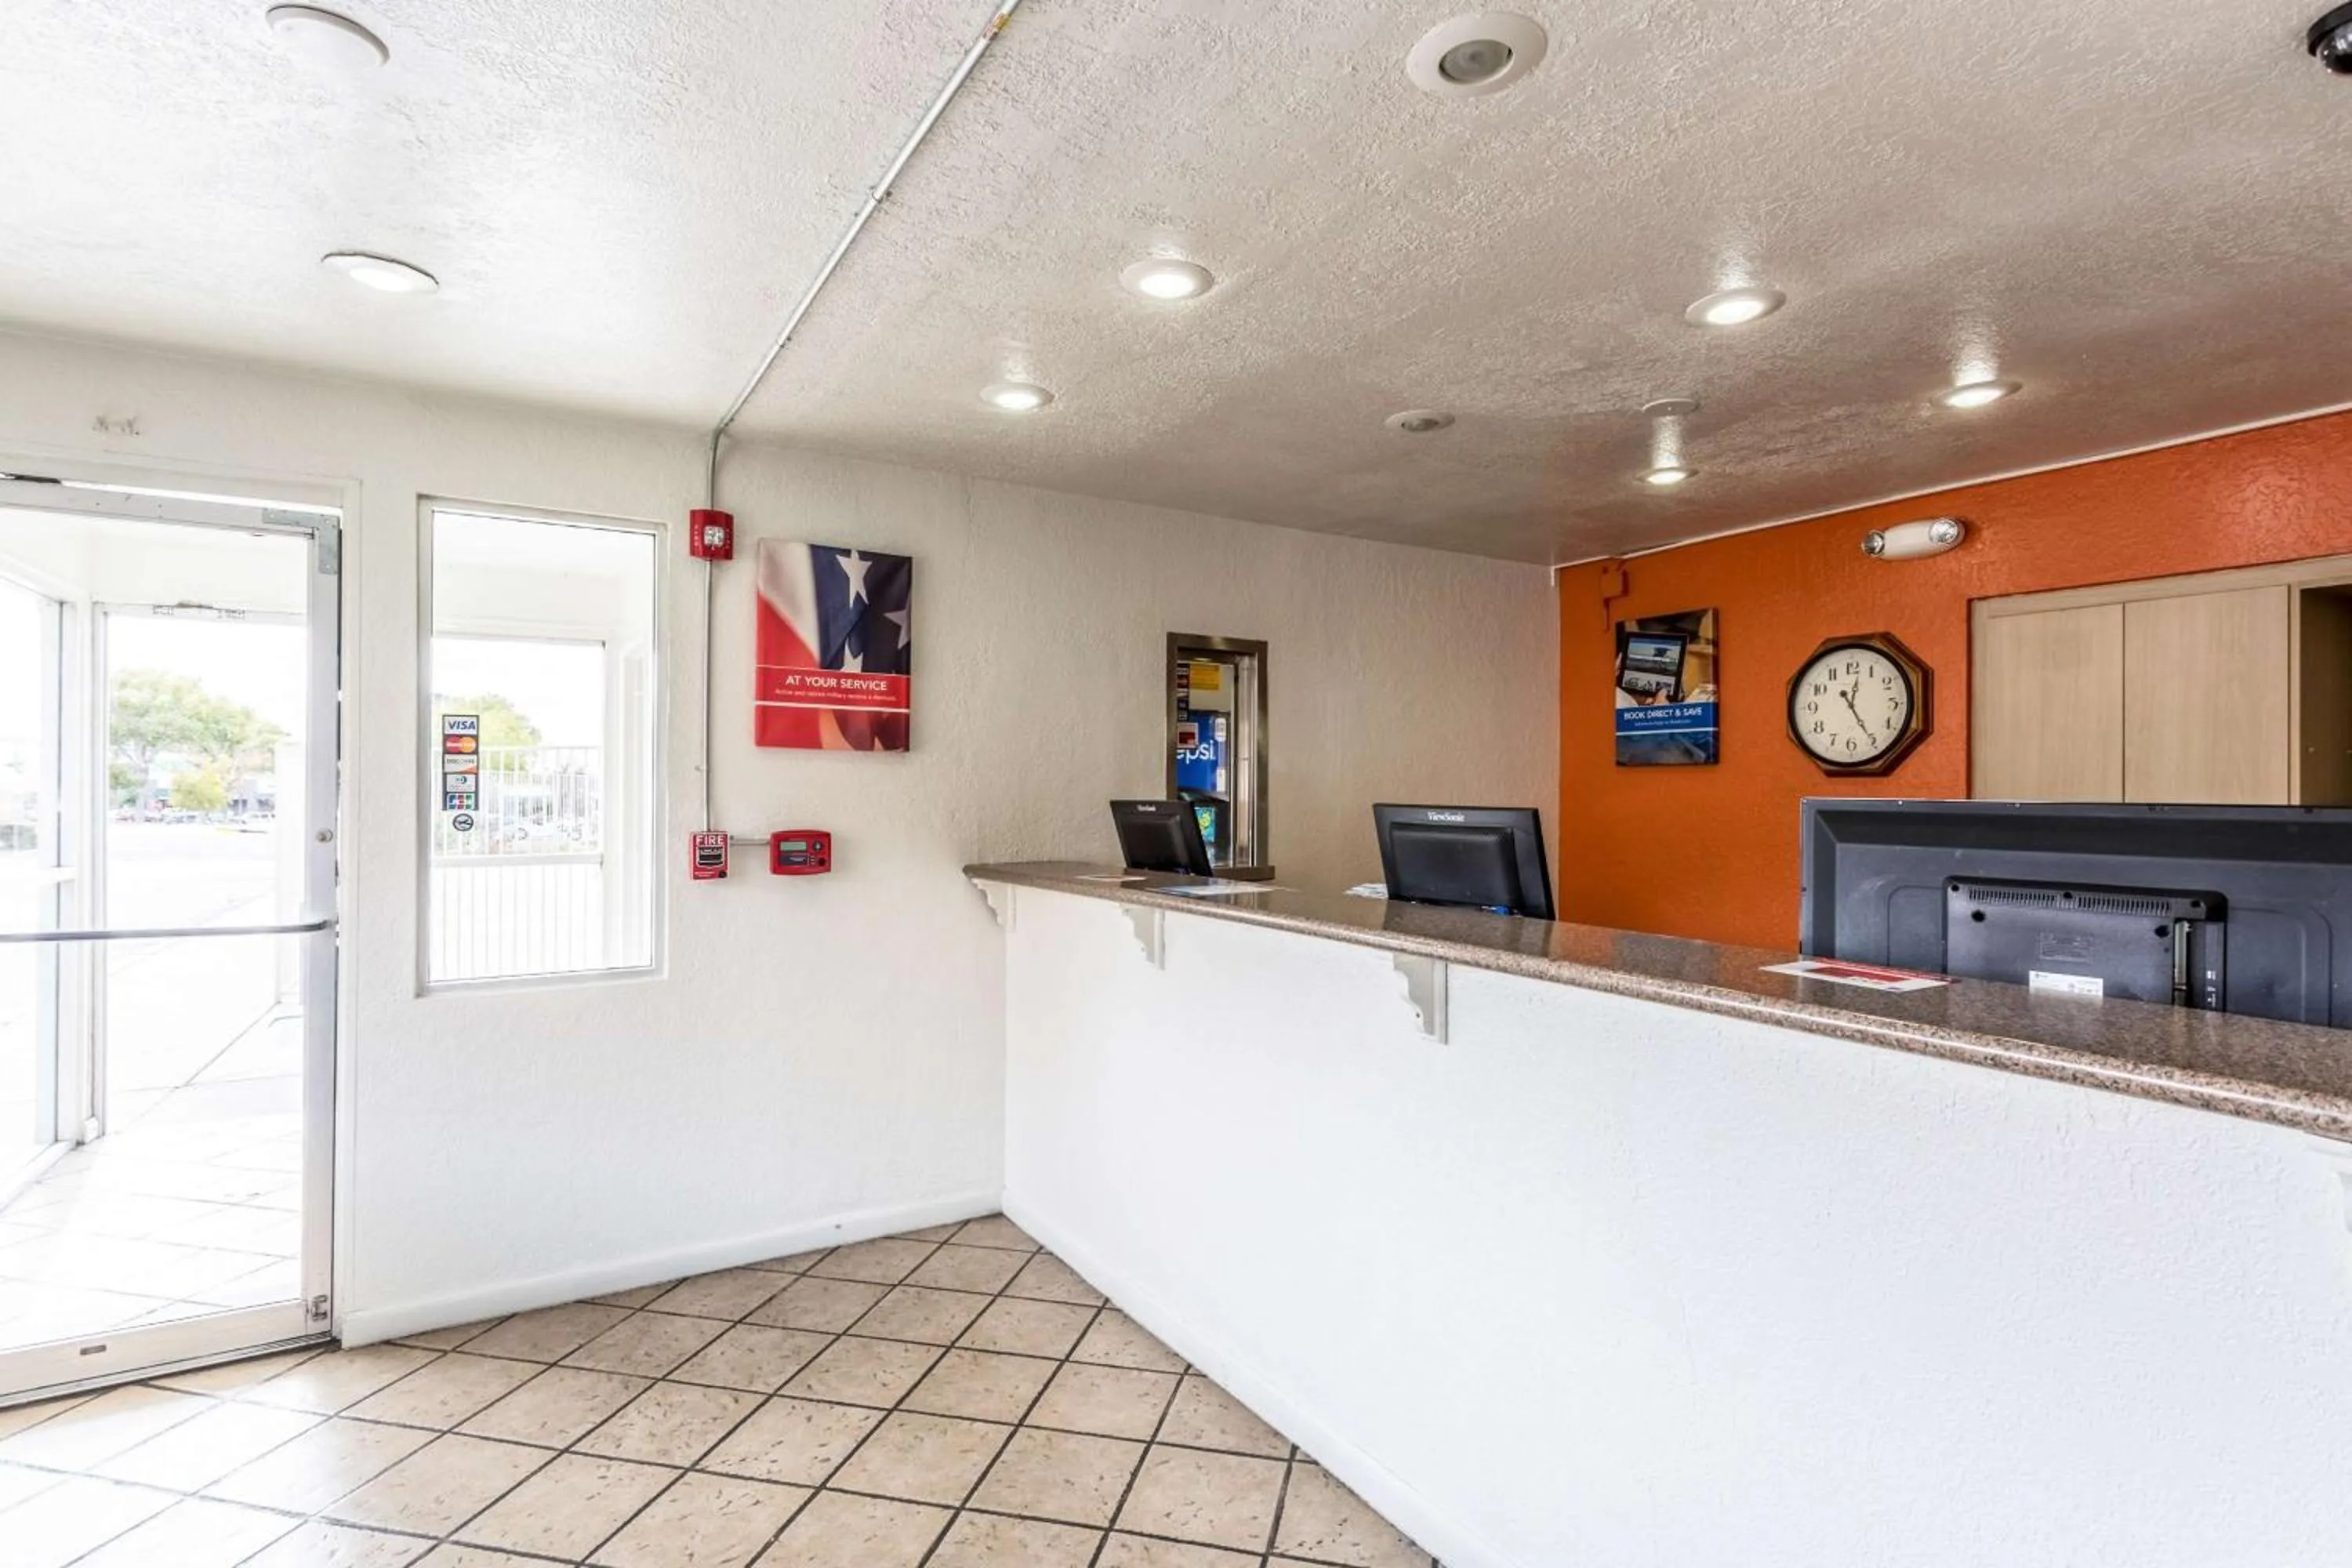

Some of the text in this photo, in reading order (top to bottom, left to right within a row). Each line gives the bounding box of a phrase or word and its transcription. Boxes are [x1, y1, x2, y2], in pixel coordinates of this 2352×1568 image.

[1828, 668, 1837, 681] 11
[1846, 662, 1860, 675] 12
[1869, 665, 1873, 677] 1
[786, 675, 887, 691] AT YOUR SERVICE
[1882, 677, 1892, 690] 2
[1813, 684, 1827, 696] 10
[1807, 702, 1818, 714] 9
[1889, 697, 1899, 710] 3
[1624, 711, 1645, 720] BOOK
[1647, 709, 1673, 718] DIRECT
[1683, 706, 1702, 716] SAVE
[448, 720, 476, 730] VISA
[1813, 721, 1824, 734] 8
[1830, 733, 1837, 746] 7
[1846, 738, 1857, 751] 6
[695, 835, 725, 846] FIRE
